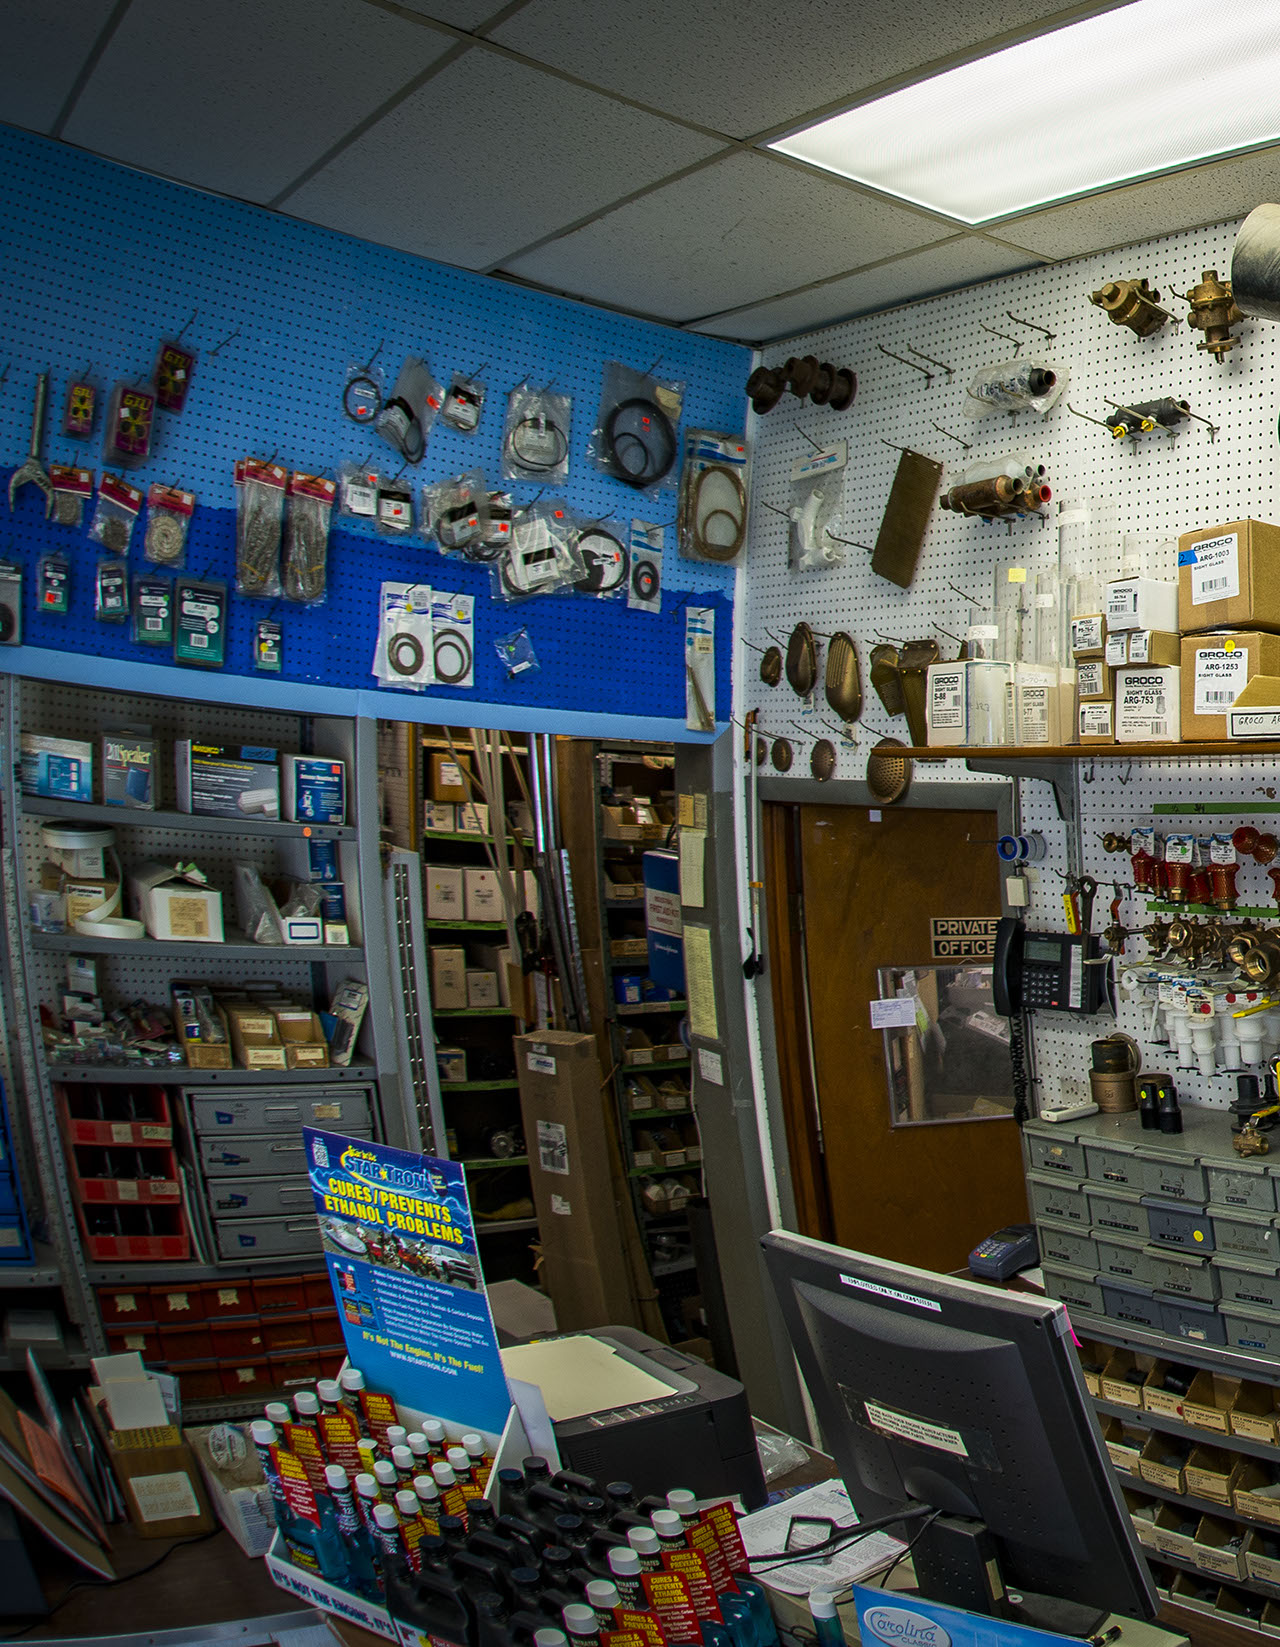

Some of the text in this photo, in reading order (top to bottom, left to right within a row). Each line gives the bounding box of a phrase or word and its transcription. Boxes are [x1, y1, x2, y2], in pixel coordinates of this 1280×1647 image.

[1193, 537, 1233, 551] GROCO
[1200, 550, 1230, 562] ARG-1003
[935, 676, 958, 684] GROCO
[1125, 677, 1163, 685] GROCO
[1124, 696, 1154, 704] ARG-753
[1238, 715, 1264, 725] GROCO
[937, 920, 998, 936] PRIVATE
[938, 940, 996, 955] OFFICE
[324, 1193, 464, 1244] ETHANOL PROBLEMS
[363, 1331, 484, 1373] It's Not The Engine, It's The Fuel!
[670, 1553, 691, 1562] CURES
[670, 1559, 702, 1568] PREVENTS
[673, 1575, 680, 1583] &
[651, 1583, 683, 1591] PREVENTS
[653, 1596, 688, 1605] PROBLEMS
[624, 1614, 645, 1623] CURES
[871, 1609, 938, 1643] Carolina
[610, 1635, 631, 1643] CURES
